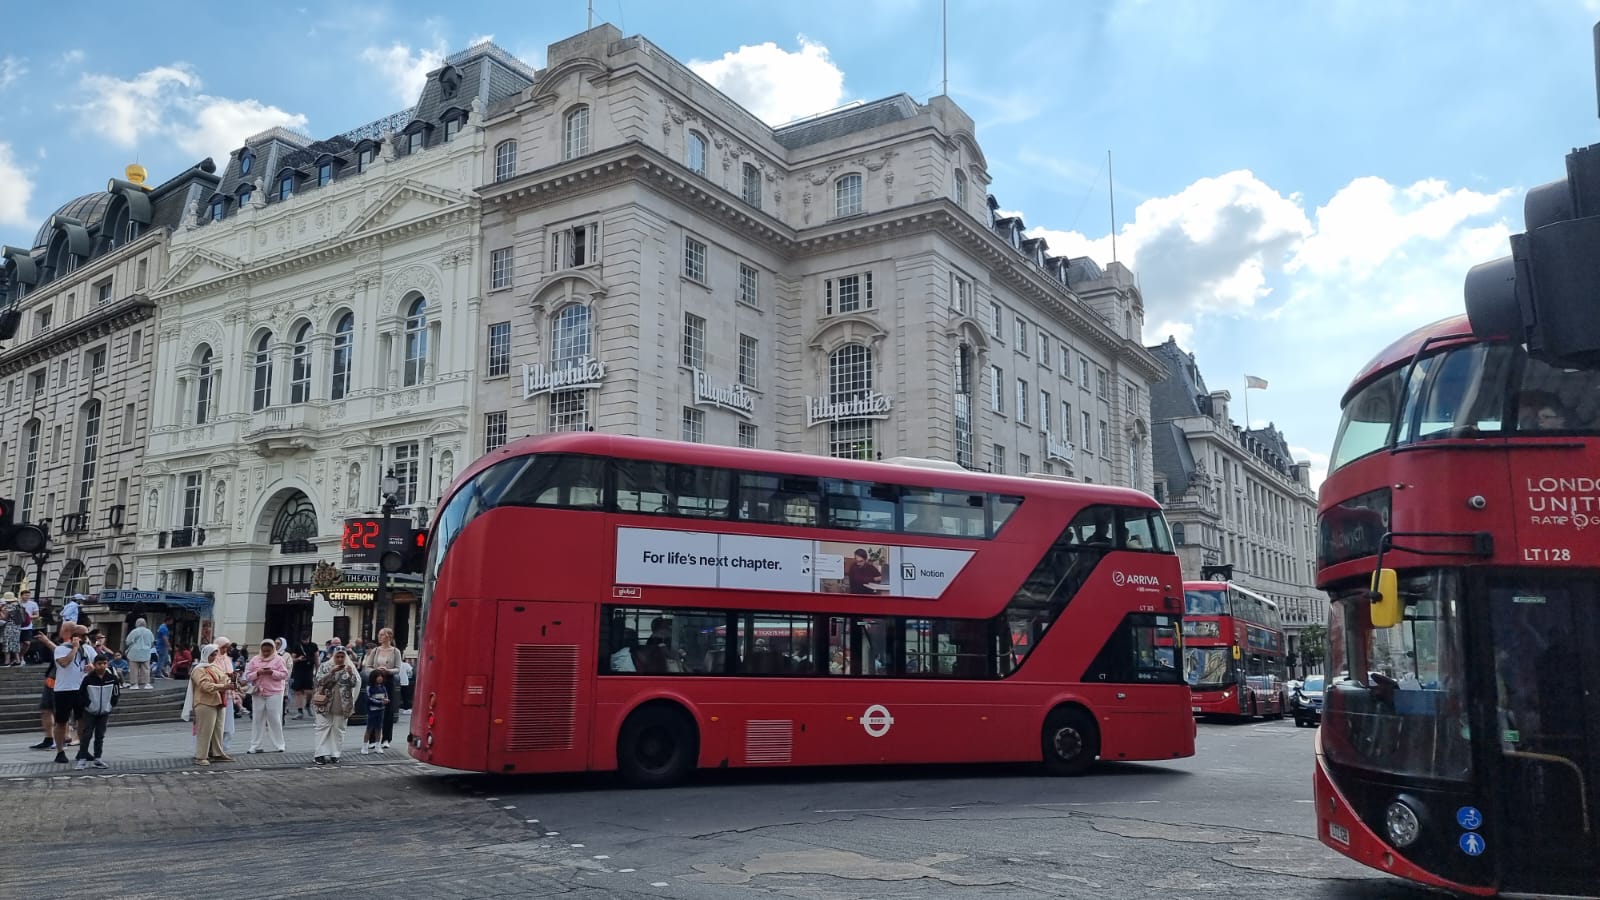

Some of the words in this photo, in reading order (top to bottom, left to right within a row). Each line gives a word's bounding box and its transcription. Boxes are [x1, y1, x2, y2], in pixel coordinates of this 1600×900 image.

[1527, 477, 1600, 492] LOND
[1529, 496, 1600, 512] UNIT
[643, 551, 665, 564] For
[699, 555, 728, 567] next
[731, 556, 783, 572] chapter.
[920, 569, 945, 578] Notion
[1126, 574, 1160, 585] ARRIVA
[329, 592, 374, 601] CRITERION
